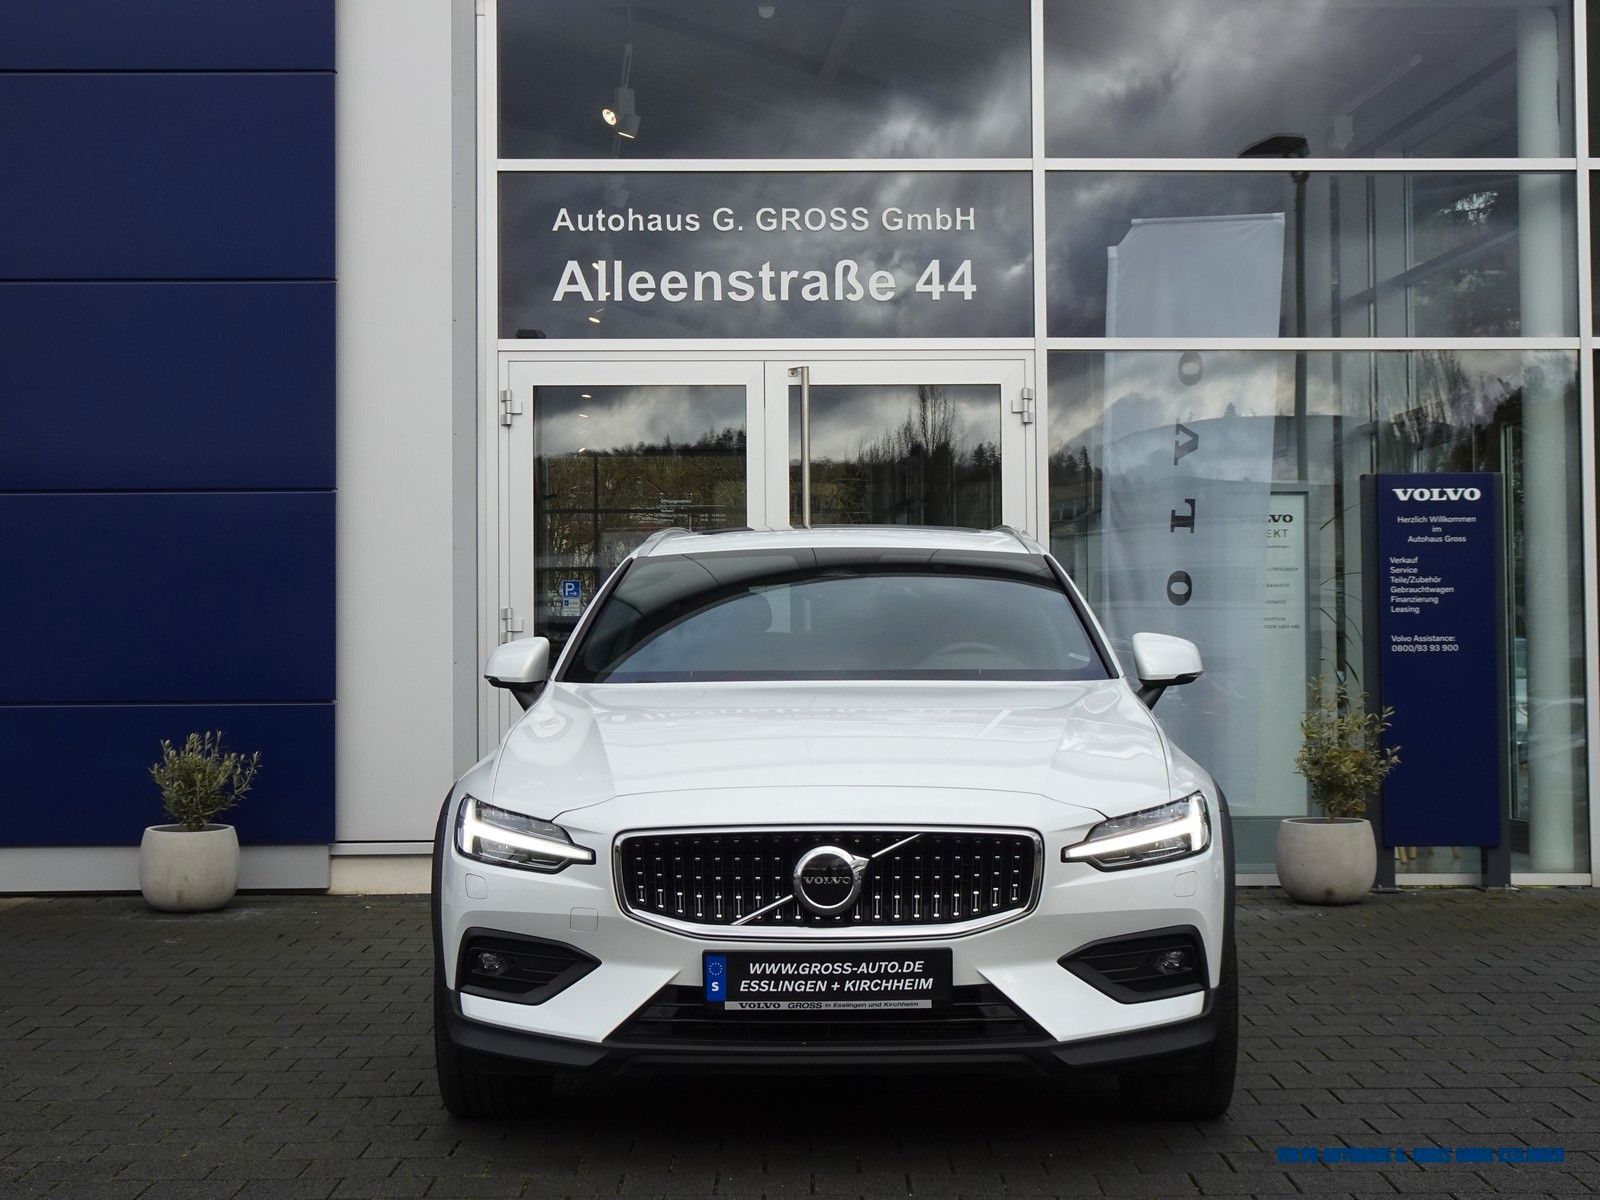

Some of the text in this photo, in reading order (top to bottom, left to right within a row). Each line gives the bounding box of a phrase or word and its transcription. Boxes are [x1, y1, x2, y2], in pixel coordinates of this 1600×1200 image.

[552, 207, 977, 233] Autohaus G. GROSS GmbH
[552, 259, 978, 303] Alleenstraße 44
[1392, 488, 1482, 501] VOLVO
[1444, 535, 1467, 543] Gross
[1390, 566, 1418, 574] Service
[1390, 576, 1442, 584] Teile/Zubehör
[565, 583, 575, 597] P
[1390, 586, 1454, 595] Gebrauchtwagen
[1390, 596, 1439, 604] Finanzierung
[1391, 606, 1420, 614] Leasing
[1391, 645, 1428, 653] 0800/93
[803, 876, 852, 885] VOLVO
[749, 960, 925, 975] WWW.GROSS-AUTO.DE
[711, 982, 719, 992] S
[739, 978, 934, 992] ESSLINGEN + KIRCHHEIM
[833, 1001, 869, 1010] Esslingen
[884, 1000, 919, 1008] Kirchheim
